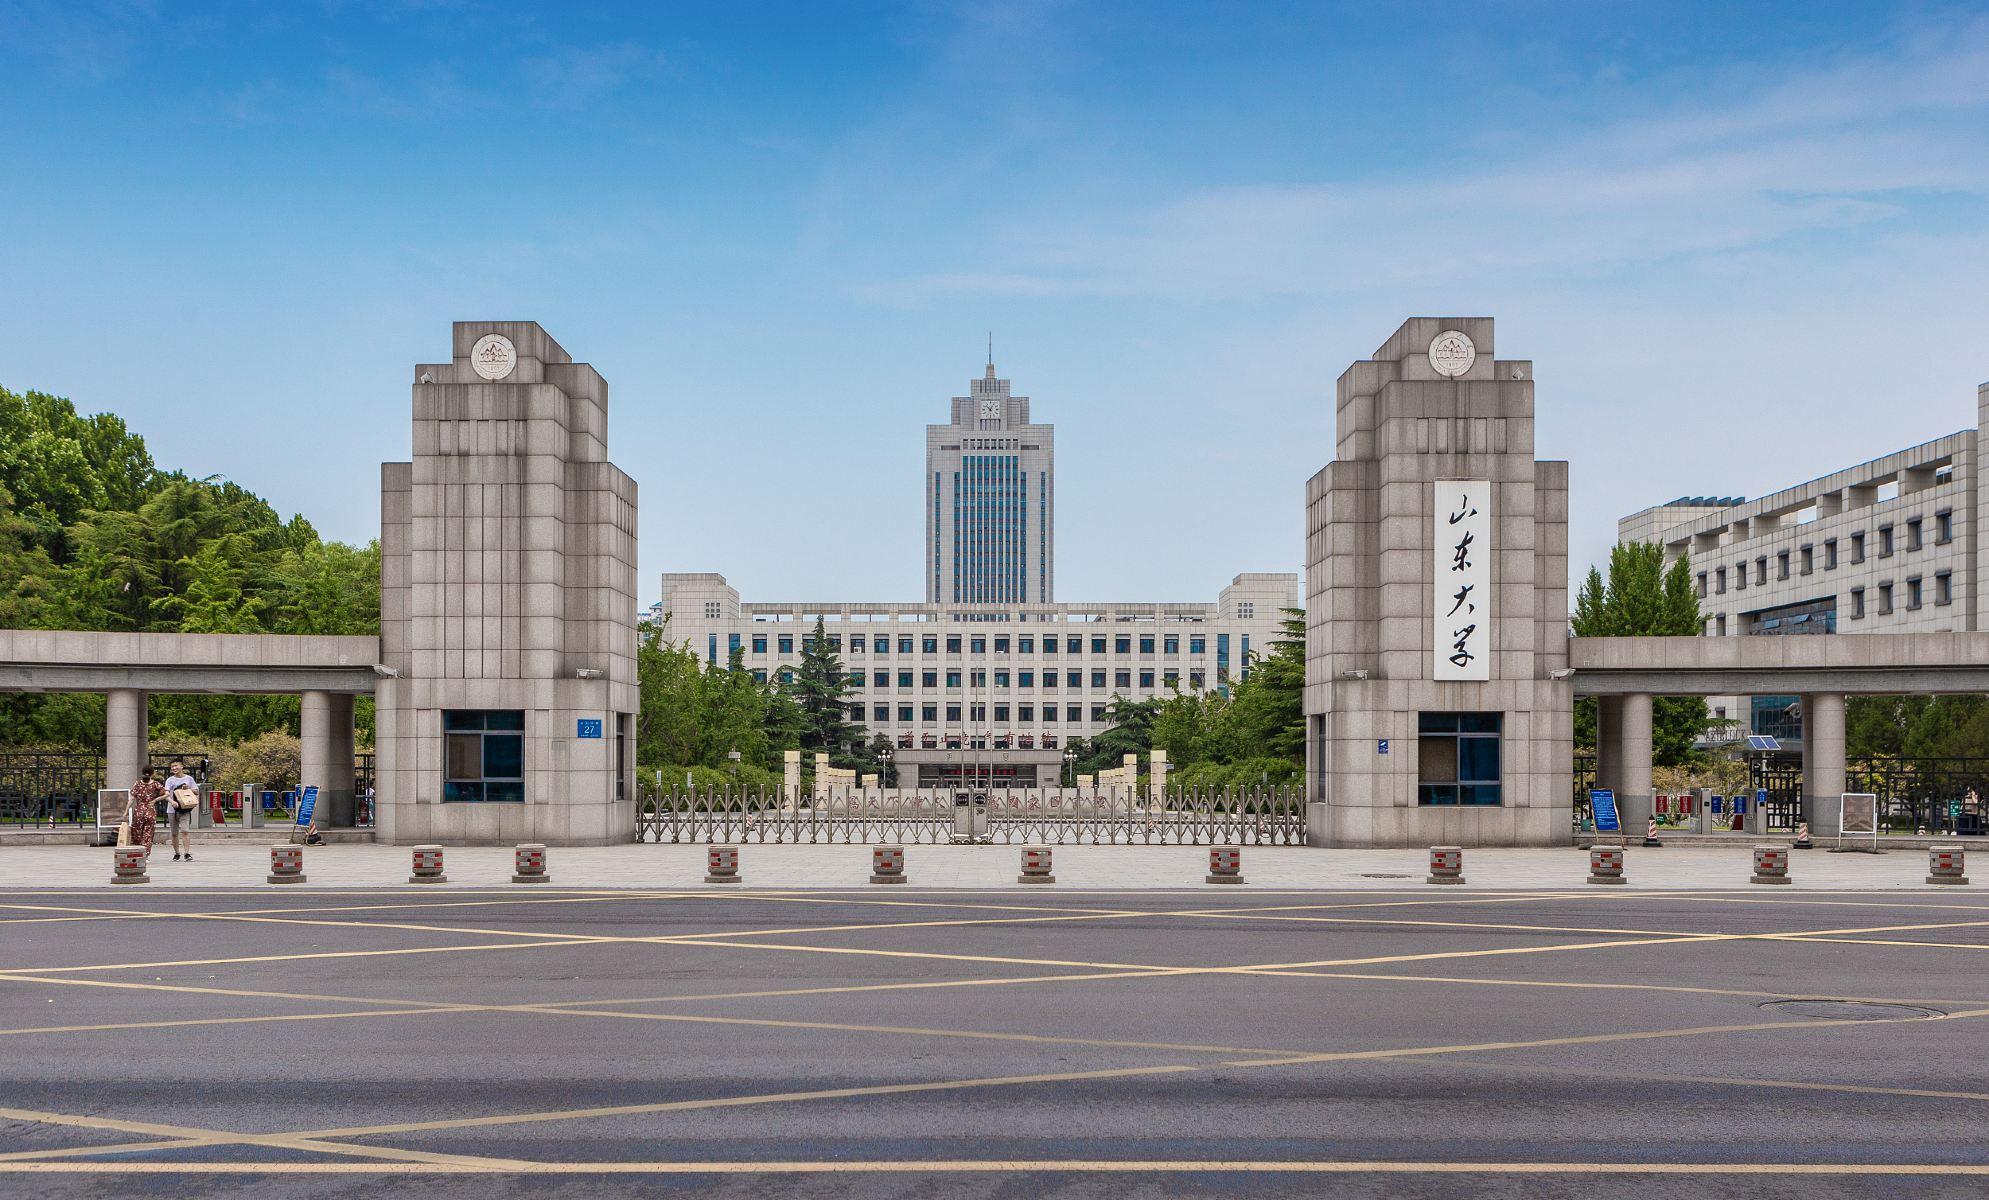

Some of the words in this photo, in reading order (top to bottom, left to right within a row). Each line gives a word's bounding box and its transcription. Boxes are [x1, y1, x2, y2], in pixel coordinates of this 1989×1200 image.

[1447, 494, 1477, 667] 山东大学
[584, 725, 595, 734] 27
